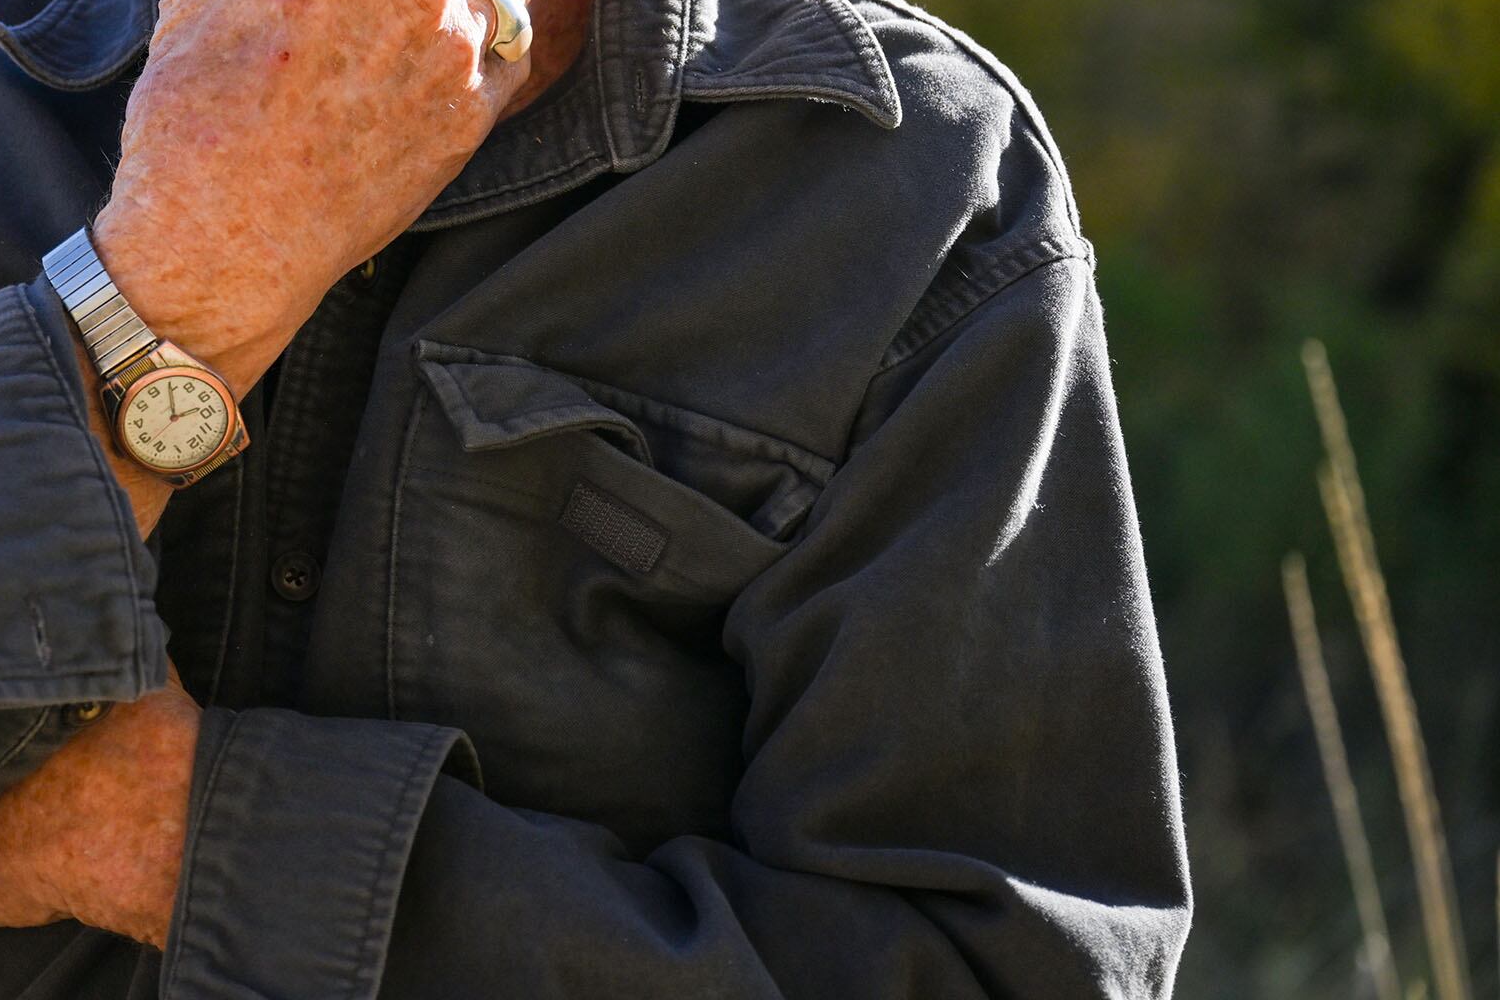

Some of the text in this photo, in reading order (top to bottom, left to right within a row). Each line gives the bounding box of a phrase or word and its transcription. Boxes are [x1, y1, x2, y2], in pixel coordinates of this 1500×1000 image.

[148, 386, 160, 398] 6
[183, 382, 195, 393] 8
[198, 390, 211, 402] 9
[136, 400, 148, 412] 5
[200, 405, 216, 419] 10
[133, 418, 144, 428] 4
[199, 422, 212, 434] 11
[139, 432, 151, 444] 3
[186, 434, 204, 449] 12
[153, 440, 166, 452] 2
[173, 444, 182, 453] 1
